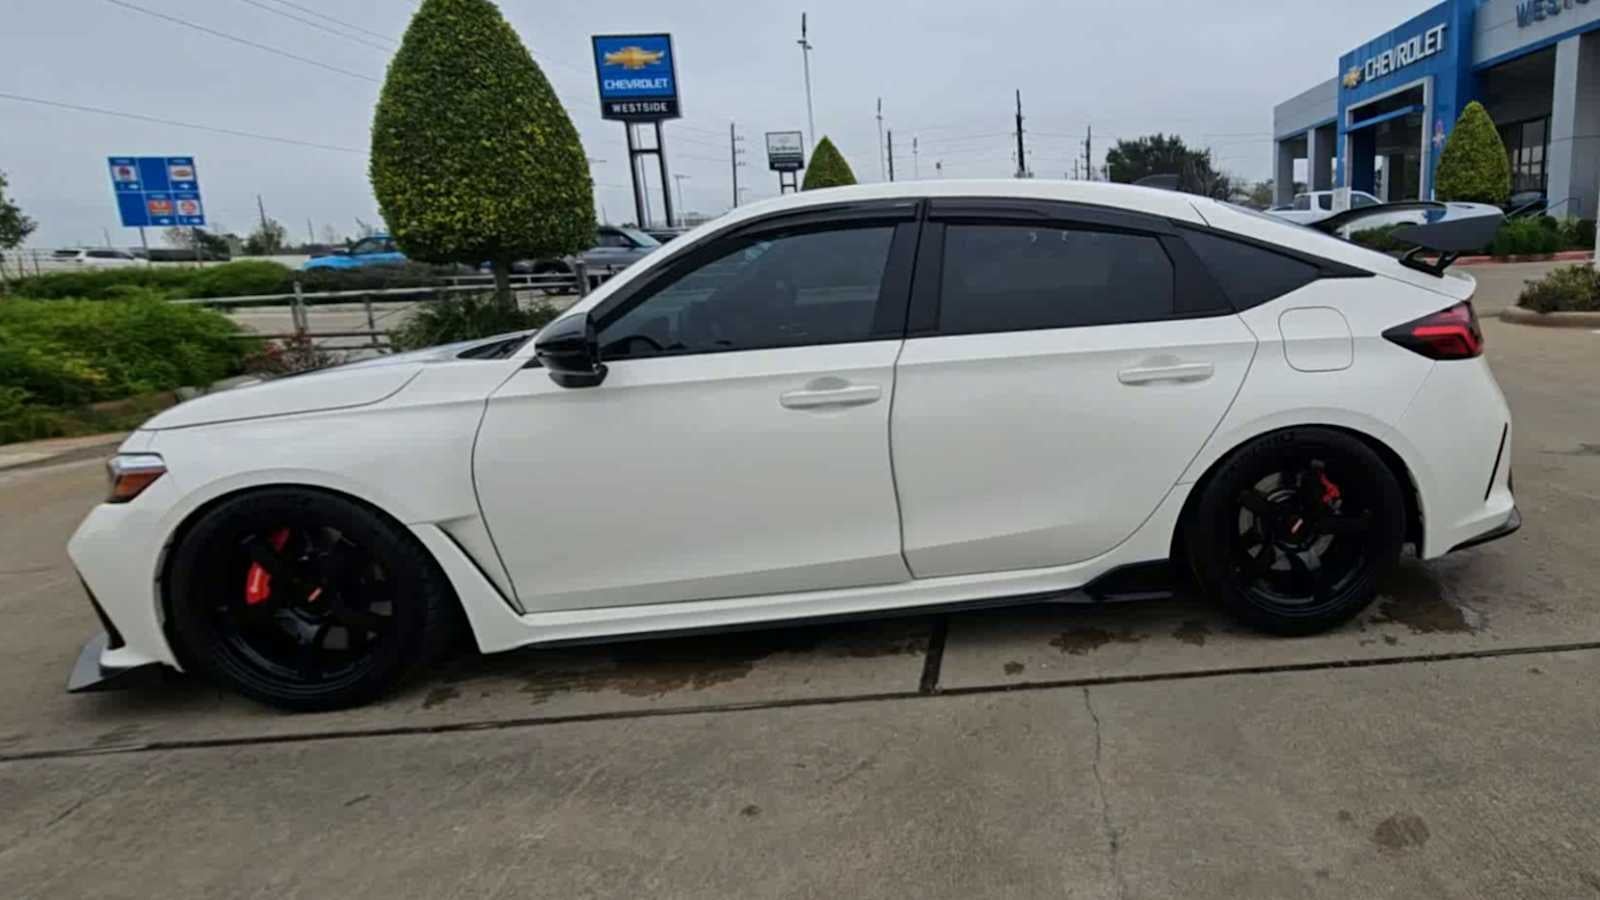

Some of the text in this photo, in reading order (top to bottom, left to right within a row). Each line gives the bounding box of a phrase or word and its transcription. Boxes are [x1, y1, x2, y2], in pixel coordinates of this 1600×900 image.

[1365, 23, 1447, 82] CHEVROLET
[603, 78, 668, 89] CHEVROLET
[611, 102, 668, 112] WESTSIDE
